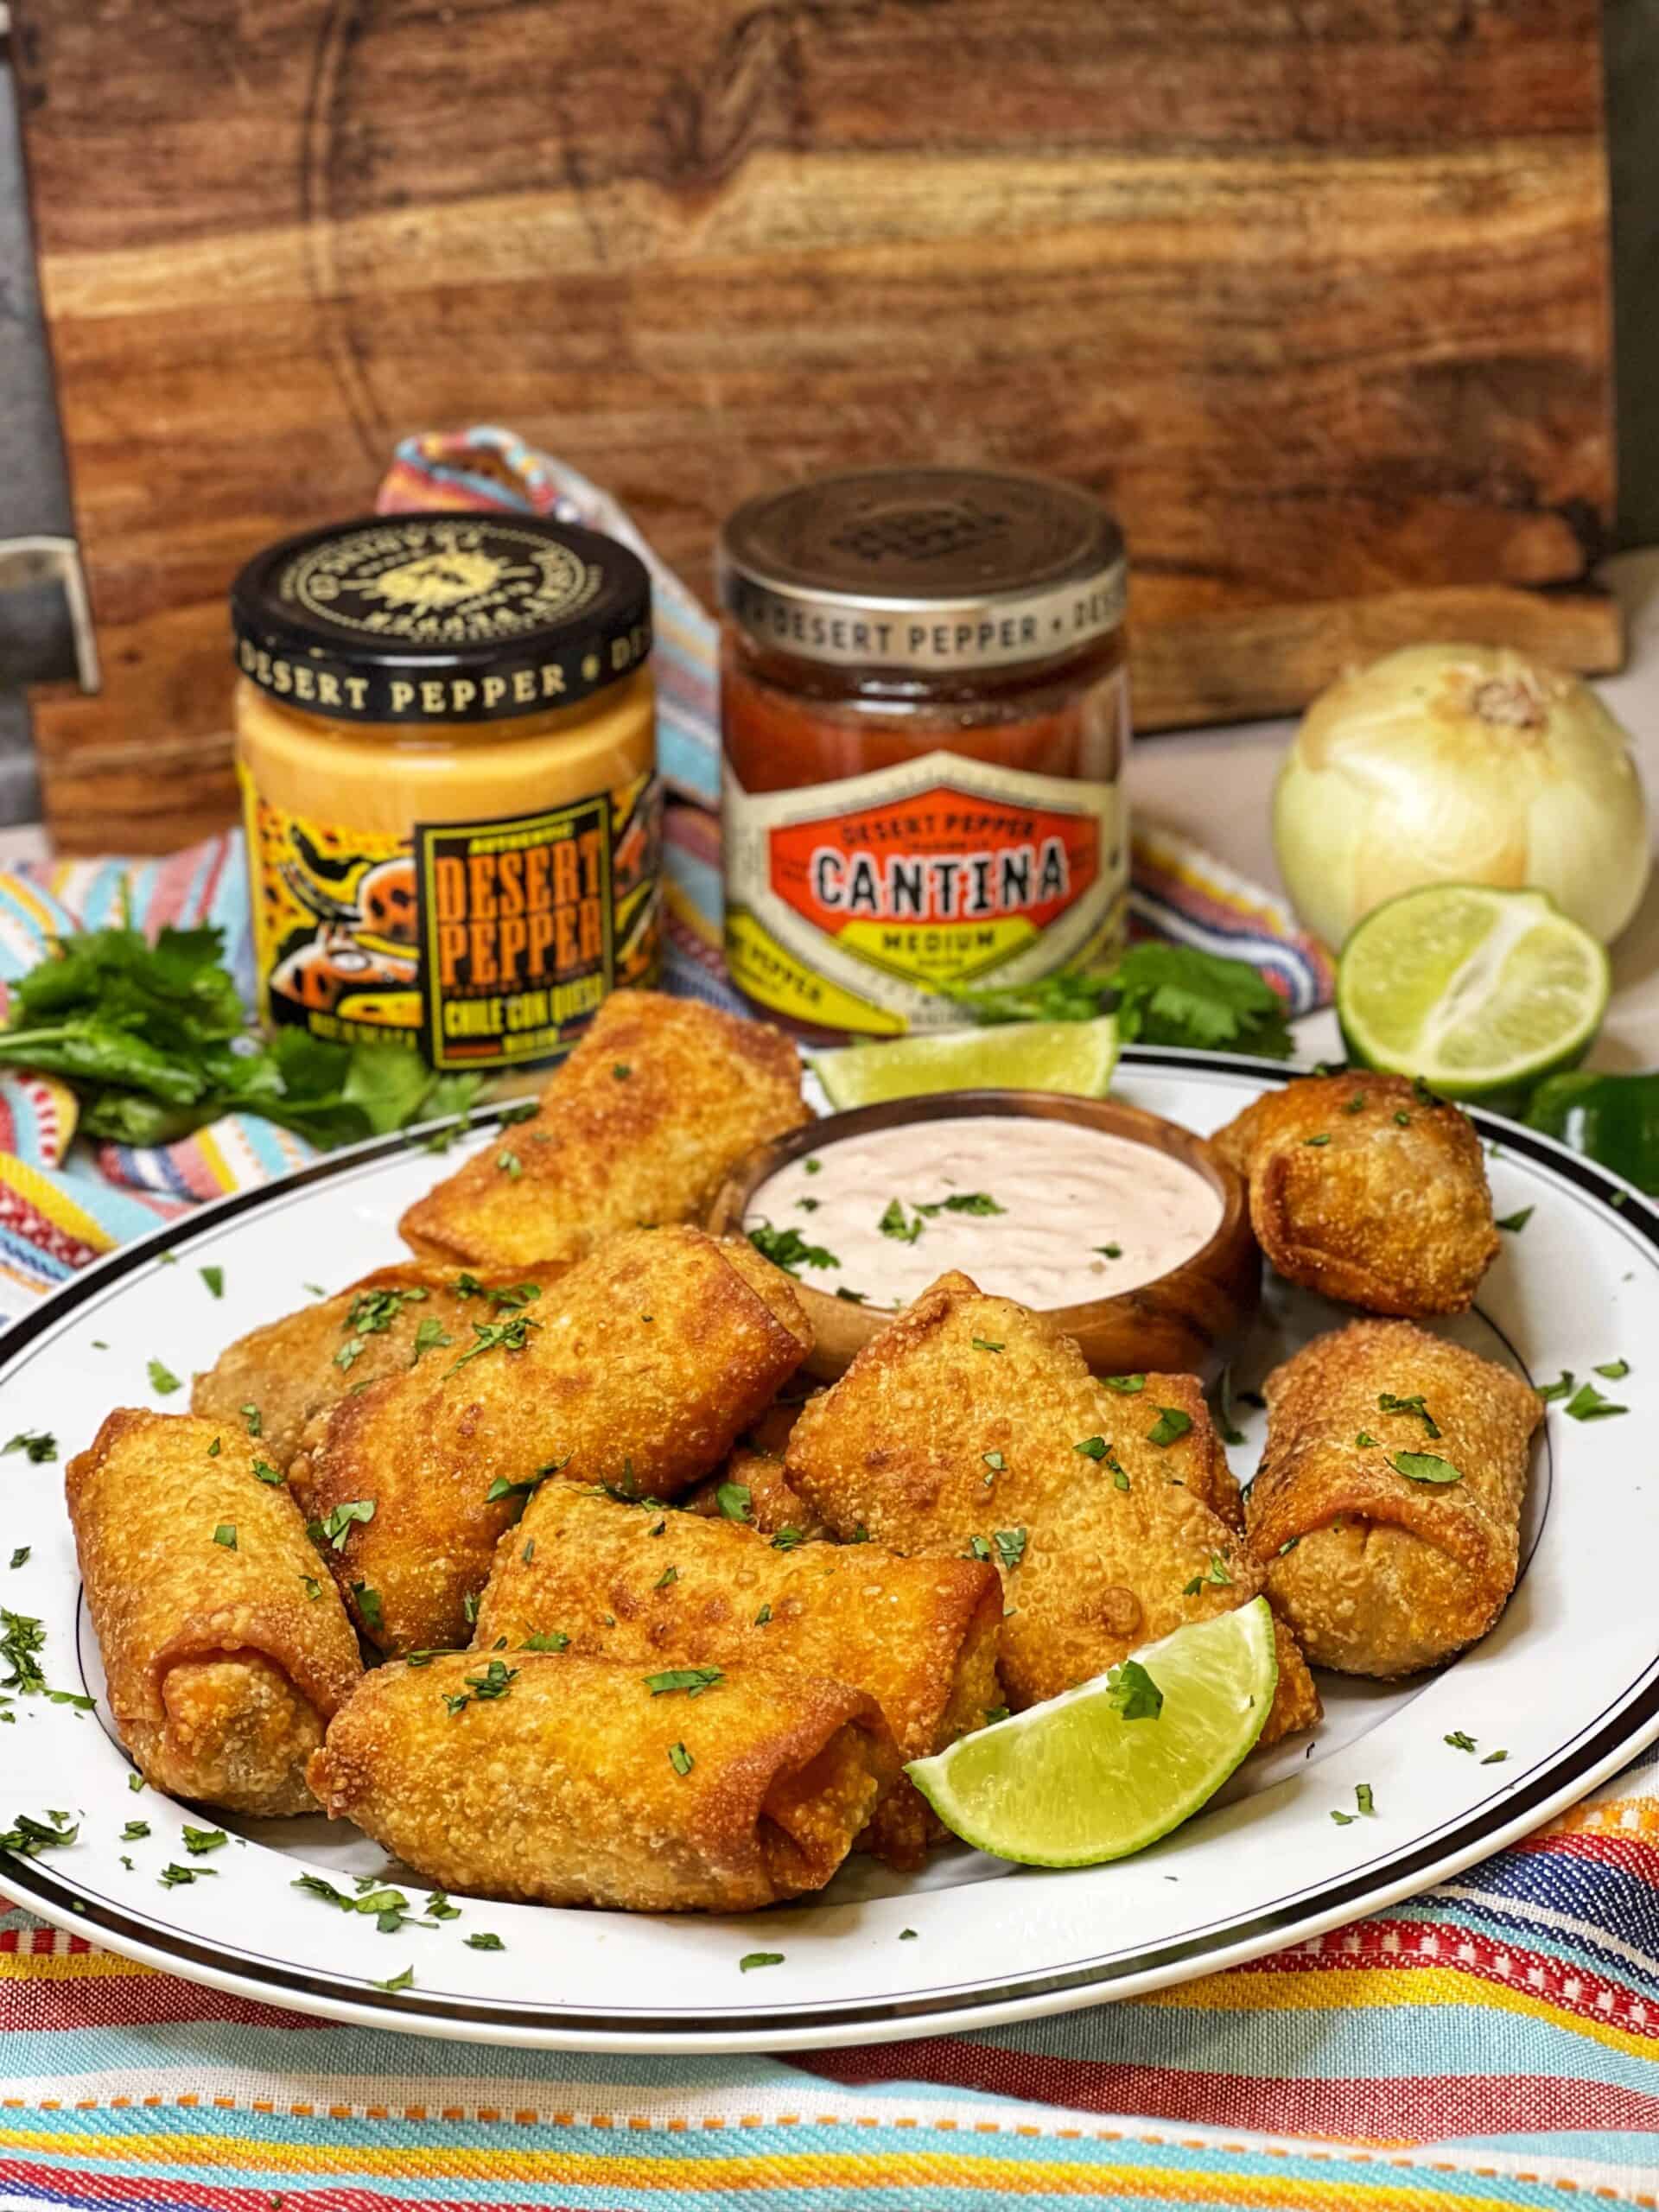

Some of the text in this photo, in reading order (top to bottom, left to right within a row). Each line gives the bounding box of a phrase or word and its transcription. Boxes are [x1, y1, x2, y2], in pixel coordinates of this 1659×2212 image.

[774, 605, 891, 653] DESERT
[910, 615, 1036, 654] PEPPER
[241, 639, 370, 710] DESERT
[391, 663, 567, 714] PEPPER
[842, 815, 935, 846] DESERT
[944, 812, 1034, 838] PEPPER
[435, 829, 602, 923] DESERT
[812, 840, 1068, 918] CANTINA
[439, 897, 602, 987] PEPPER
[883, 929, 996, 953] MEDIUM
[444, 997, 504, 1037] CHILE
